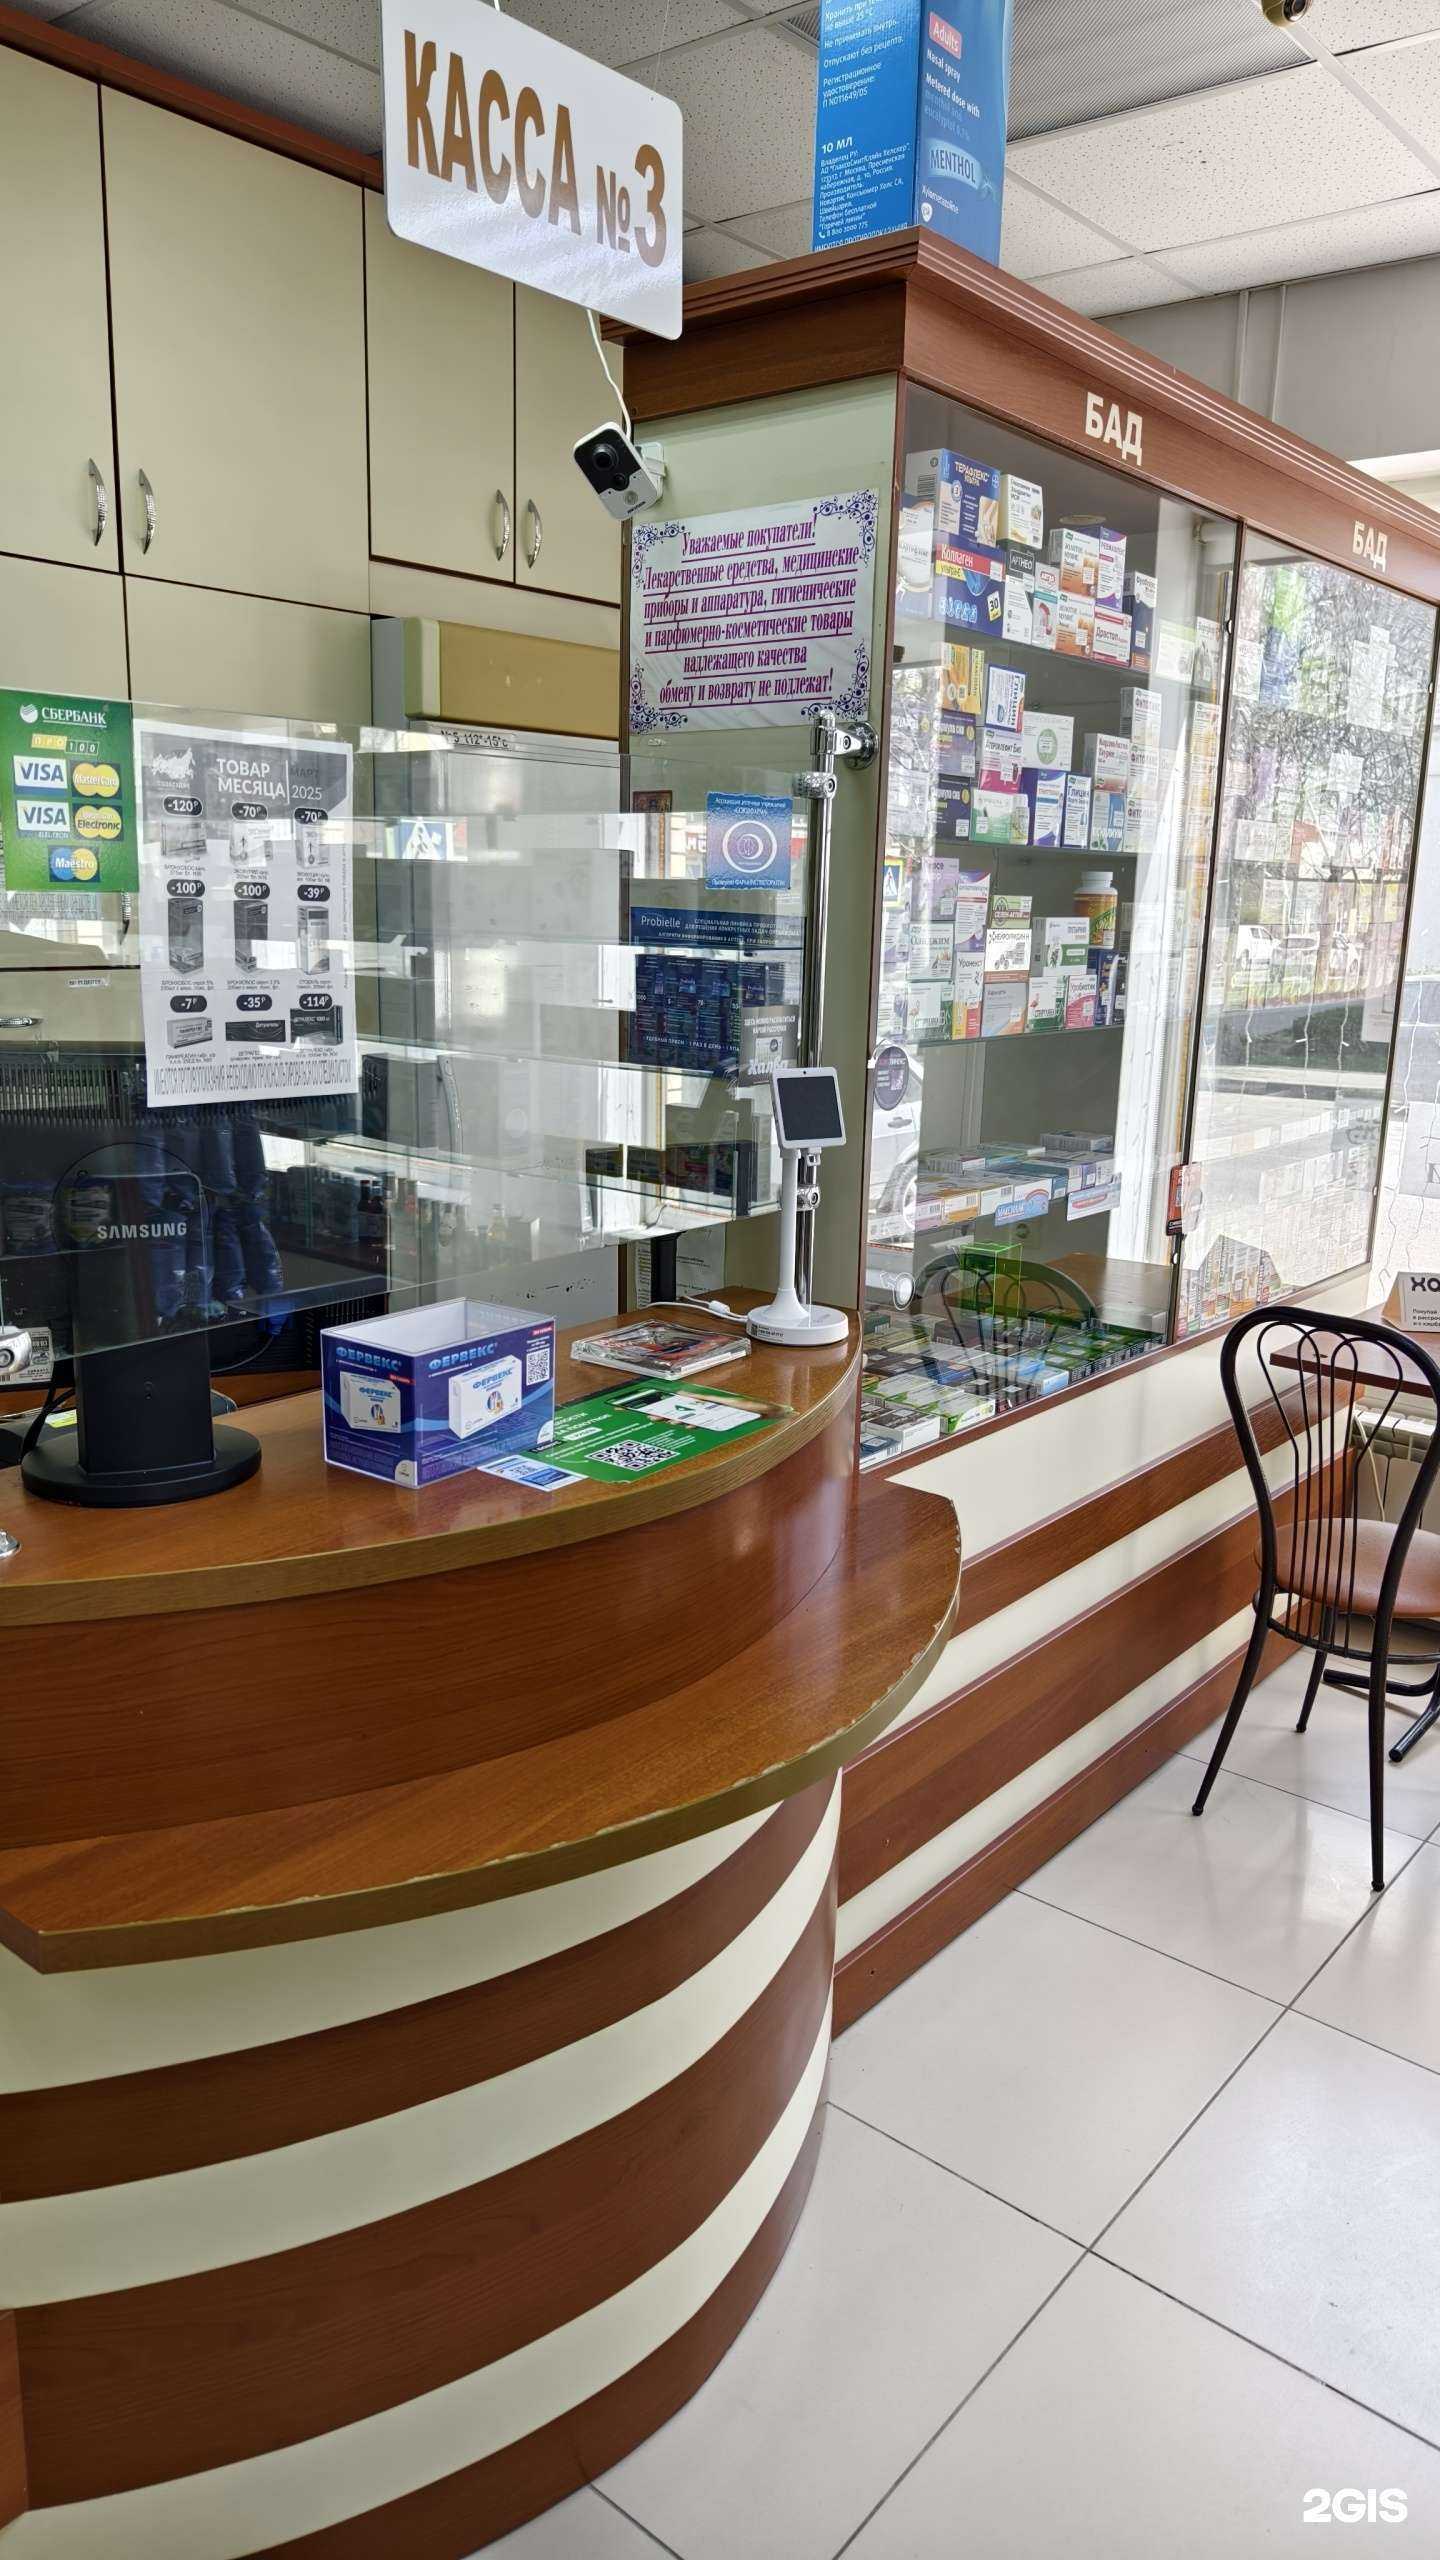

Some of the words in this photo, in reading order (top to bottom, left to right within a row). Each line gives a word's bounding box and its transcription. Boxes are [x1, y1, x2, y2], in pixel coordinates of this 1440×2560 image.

[933, 22, 960, 53] Adults
[926, 49, 945, 70] Nasal
[944, 62, 961, 84] spray
[926, 72, 951, 99] Metered
[951, 91, 967, 112] dose
[966, 101, 981, 119] with
[404, 29, 582, 236] КАССА
[821, 143, 834, 154] 10
[836, 136, 853, 151] МЛ
[930, 148, 976, 184] MENTHOL
[1085, 391, 1143, 466] БАД
[682, 531, 745, 556] Уважаемые
[747, 513, 818, 550] покупатели!
[1352, 520, 1389, 573] БАД
[643, 565, 725, 592] Лекарственные
[727, 557, 778, 586] средства,
[782, 546, 860, 576] медицинские
[643, 593, 690, 625] приборы
[691, 598, 699, 613] и
[700, 591, 768, 618] аппаратура,
[771, 577, 857, 605] гигиенические
[644, 632, 652, 648] и
[654, 614, 808, 651] парфюмерно-косметические
[810, 611, 853, 636] товары
[683, 652, 755, 675] надлежащего
[757, 645, 808, 667] качества
[659, 679, 696, 708] обмену
[698, 684, 706, 700] и
[708, 681, 756, 704] возврату
[758, 680, 772, 697] не
[774, 667, 834, 699] подлежат!
[41, 706, 107, 725] СБЕРБАНК
[20, 761, 65, 782] VISA
[216, 758, 271, 779] ТОВАР
[217, 776, 286, 800] МЕСЯЦА
[291, 784, 323, 801] 2025
[23, 806, 68, 825] VISA
[77, 819, 121, 831] Electronic
[55, 857, 95, 869] Maestro
[641, 915, 681, 928] Probielle
[97, 1222, 188, 1239] SAMSUNG
[335, 1346, 399, 1371] ФЕРВЕКС
[428, 1343, 495, 1370] ФЕРВЕКС
[472, 1368, 513, 1390] ФЕРВЕКС
